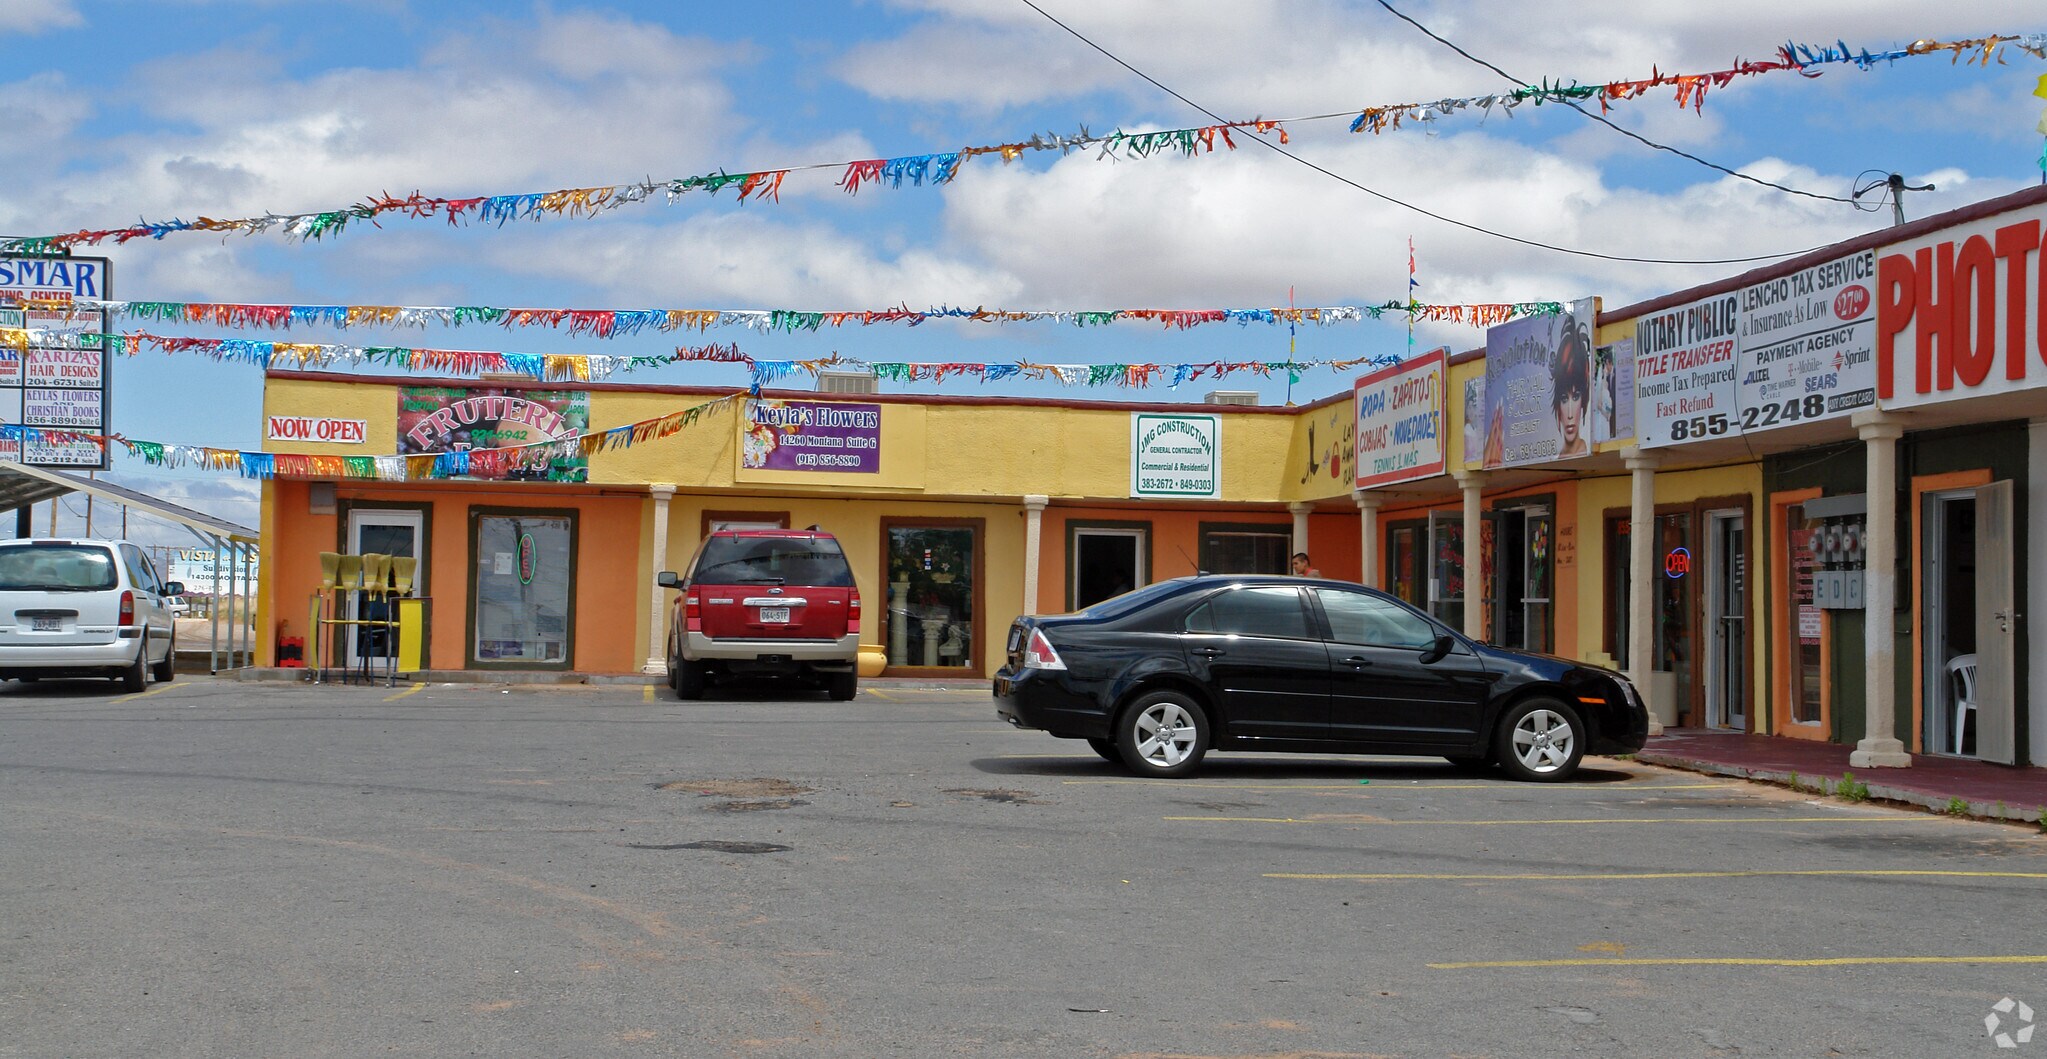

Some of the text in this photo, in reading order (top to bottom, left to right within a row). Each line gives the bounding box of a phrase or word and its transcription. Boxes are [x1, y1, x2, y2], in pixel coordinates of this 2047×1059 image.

[1742, 253, 1874, 313] LENCHO TAX SERVICE
[1742, 321, 1748, 337] &
[1750, 309, 1792, 336] Insurance
[1793, 301, 1804, 324] As
[1806, 297, 1828, 321] Low
[1878, 219, 2047, 399] PHOT
[1636, 296, 1737, 357] NOTARY PUBLIC
[1757, 328, 1855, 365] PAYMENT AGENCY
[29, 351, 100, 366] KARIZA'S
[1637, 339, 1734, 379] TITLE TRANSFER
[1844, 347, 1870, 369] Sprint
[30, 365, 98, 377] HAIR DESIGNS
[1638, 381, 1670, 399] Income
[1672, 374, 1689, 393] Tax
[1692, 363, 1736, 391] Prepared
[1767, 378, 1796, 392] TIME WARNER
[1805, 372, 1837, 393] SEARS
[62, 391, 100, 402] FLOWERS
[403, 399, 439, 410] TORTAS
[1361, 374, 1433, 420] ROPA ZAPATOS
[1656, 392, 1714, 418] Fast Refund
[1839, 393, 1858, 408] CREDIT
[26, 405, 99, 417] CHRISTIAN BOOKS
[756, 405, 878, 428] Keyla's Flowers
[1671, 394, 1824, 441] 855-2248
[271, 418, 365, 440] NOW OPEN
[1141, 421, 1211, 455] JMG CONSTRUCTION
[1360, 410, 1439, 453] COBIJAS NOVEDADES
[780, 435, 876, 448] 14260 Montana Suite G
[796, 453, 860, 466] (915) 856-8890
[1141, 462, 1210, 471] Commercial & Residential
[1374, 455, 1395, 473] TENNIS
[1404, 450, 1418, 467] MAS
[1142, 479, 1211, 490] 383-2672 849-0303
[1666, 553, 1689, 573] OPEN
[1817, 580, 1823, 598] E
[1834, 580, 1839, 599] D
